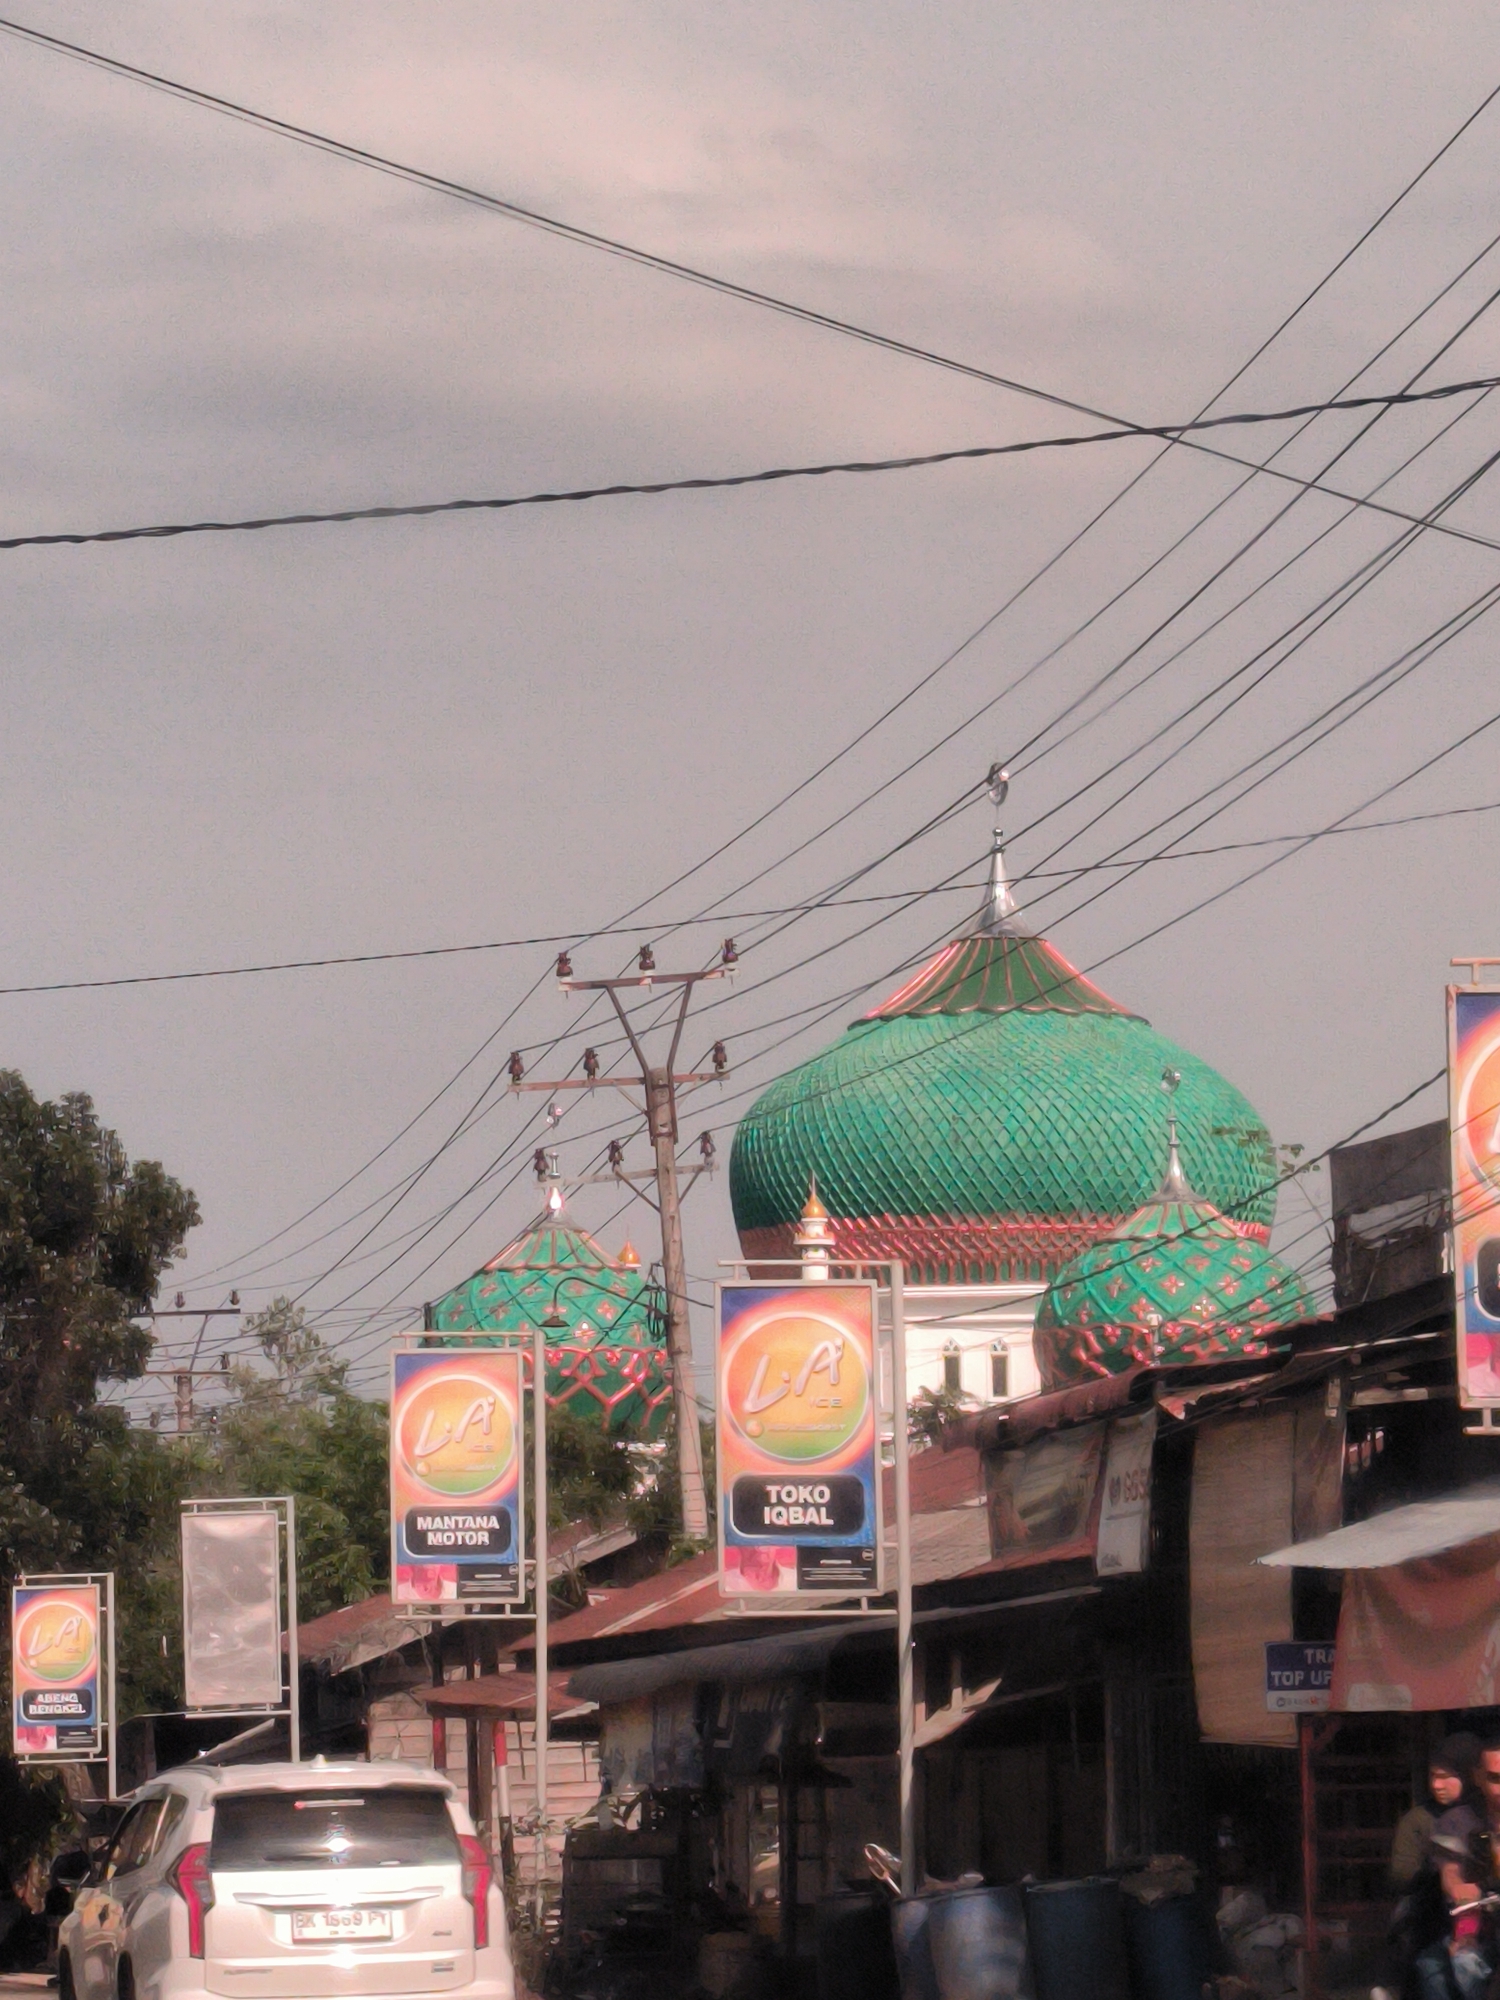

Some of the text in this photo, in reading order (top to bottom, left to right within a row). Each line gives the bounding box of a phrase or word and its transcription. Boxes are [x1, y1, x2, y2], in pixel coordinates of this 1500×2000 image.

[765, 1485, 830, 1504] TOKO
[416, 1515, 500, 1530] MANTANA
[763, 1506, 834, 1526] IQBAL
[427, 1531, 490, 1546] MOTOR
[1270, 1670, 1304, 1687] TOP
